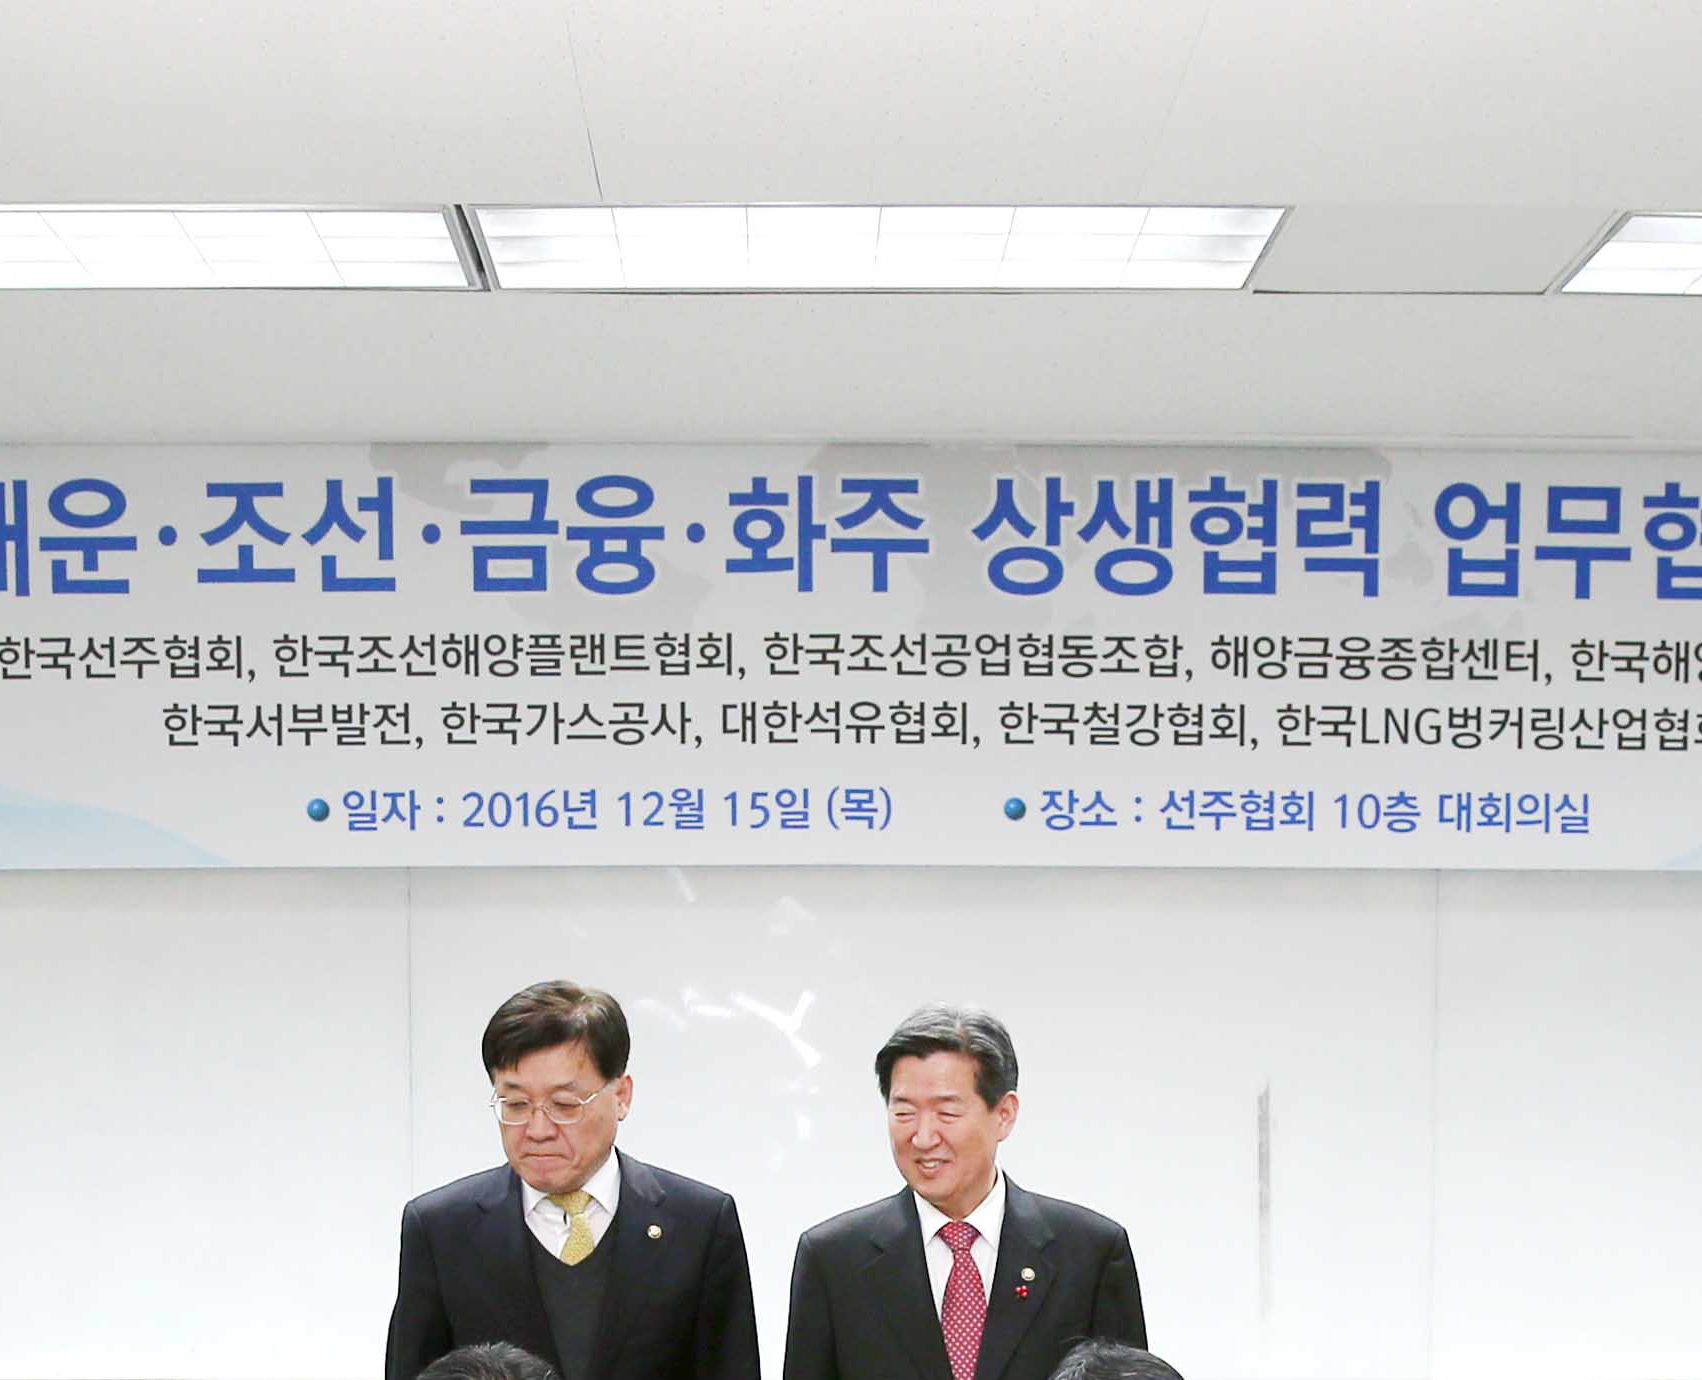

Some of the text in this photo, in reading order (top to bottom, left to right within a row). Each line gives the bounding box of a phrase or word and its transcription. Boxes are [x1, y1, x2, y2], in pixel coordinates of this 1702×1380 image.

[971, 475, 1381, 598] 상생협력
[272, 631, 746, 681] 한국조선해양플랜트협회,
[763, 631, 1193, 682] 한국조선공업협동조합,
[1210, 634, 1552, 686] 해양금융종합센터,
[162, 702, 423, 750] 한국서부발전,
[440, 701, 702, 749] 한국가스공사,
[722, 700, 980, 749] 대한석유협회,
[998, 700, 1258, 751] 한국철강협회,
[342, 789, 421, 832] 일자
[462, 788, 598, 830] 2016년
[618, 788, 705, 830] 12월
[723, 788, 810, 829] 15일
[827, 786, 892, 830] (목)
[1040, 789, 1118, 831] 장소
[1159, 789, 1314, 832] 선주협회
[1334, 791, 1421, 833] 10층
[1438, 791, 1589, 834] 대회의실
